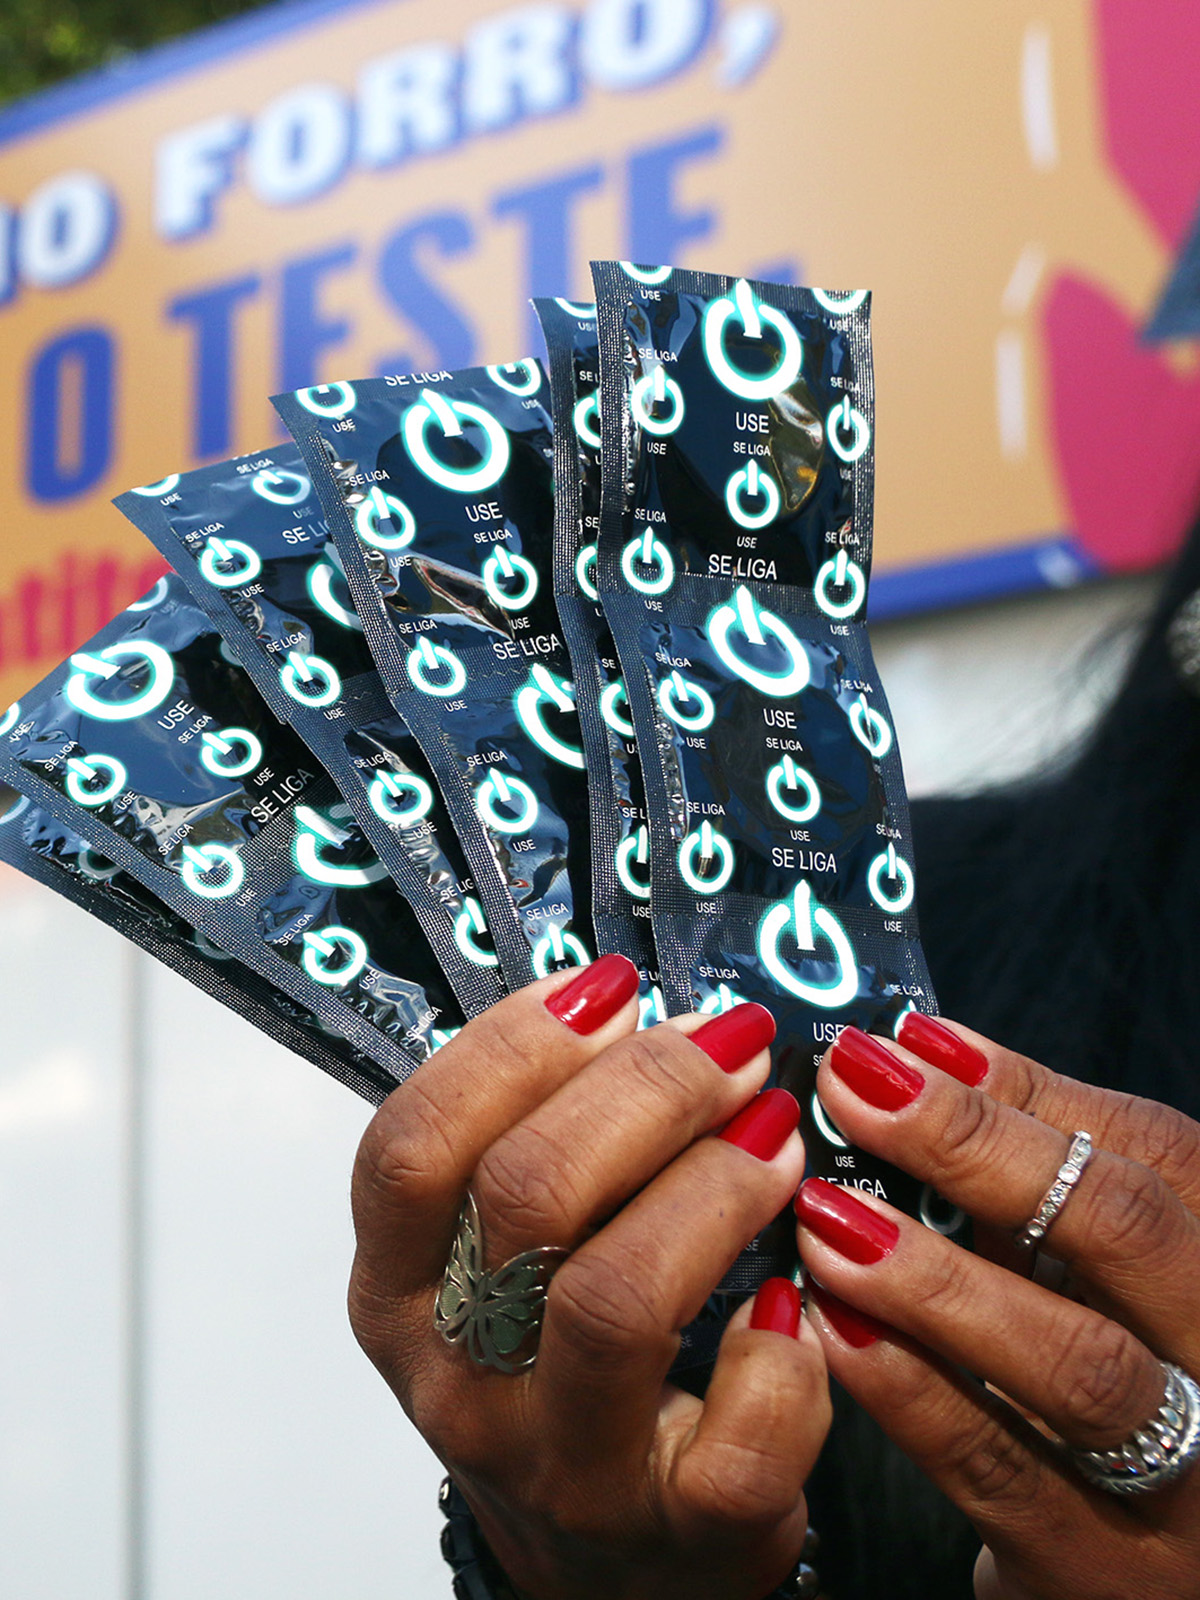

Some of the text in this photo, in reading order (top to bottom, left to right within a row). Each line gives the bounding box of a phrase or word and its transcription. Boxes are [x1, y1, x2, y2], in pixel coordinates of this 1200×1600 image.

[640, 290, 662, 301] USE
[638, 348, 678, 363] SE LIGA
[385, 370, 453, 386] SE LIGA
[579, 371, 593, 382] SE
[830, 376, 843, 388] SE
[25, 325, 116, 508] O
[736, 411, 769, 434] USE
[332, 419, 356, 433] USE
[647, 442, 667, 455] USE
[733, 441, 771, 456] SE LIGA
[236, 458, 274, 474] SE LIGA
[349, 469, 390, 487] SE LIGA
[160, 492, 182, 507] USE
[465, 502, 503, 523] USE
[635, 508, 667, 523] SE LIGA
[585, 517, 600, 528] SE
[185, 522, 225, 543] SE LIGA
[282, 527, 310, 544] SE
[473, 528, 513, 544] SE LIGA
[825, 531, 860, 545] SE LIGA
[736, 536, 757, 549] USE
[390, 554, 411, 568] USE
[708, 554, 777, 580] SE LIGA
[241, 583, 265, 599] USE
[644, 600, 664, 612] USE
[399, 619, 438, 634] SE LIGA
[511, 616, 531, 630] USE
[266, 631, 307, 653] SE LIGA
[493, 633, 563, 660] SE LIGA
[601, 658, 617, 669] SE
[655, 652, 692, 668] SE LIGA
[444, 699, 468, 712] USE
[157, 700, 195, 730] USE
[323, 707, 346, 721] USE
[763, 708, 797, 729] USE
[177, 714, 213, 744] SE LIGA
[686, 737, 707, 749] USE
[765, 737, 803, 751] SE LIGA
[44, 740, 79, 772] SE LIGA
[353, 751, 392, 769] SE LIGA
[466, 750, 508, 767] SE LIGA
[253, 767, 275, 787] USE
[117, 791, 138, 812] USE
[251, 768, 315, 824] SE LIGA
[622, 807, 638, 818] SE
[686, 802, 725, 816] SE LIGA
[413, 822, 437, 839] USE
[790, 830, 811, 842] USE
[158, 822, 194, 856] SE LIGA
[513, 839, 536, 852] USE
[772, 847, 837, 873] SE LIGA
[440, 877, 474, 900] SE LIG
[236, 887, 257, 907] USE
[526, 902, 569, 921] SE LIGA
[696, 902, 717, 914] USE
[279, 913, 314, 946] SE LIGA
[884, 920, 902, 932] USE
[359, 969, 381, 991] USE
[700, 966, 740, 979] SE LIGA
[835, 1156, 856, 1168] USE
